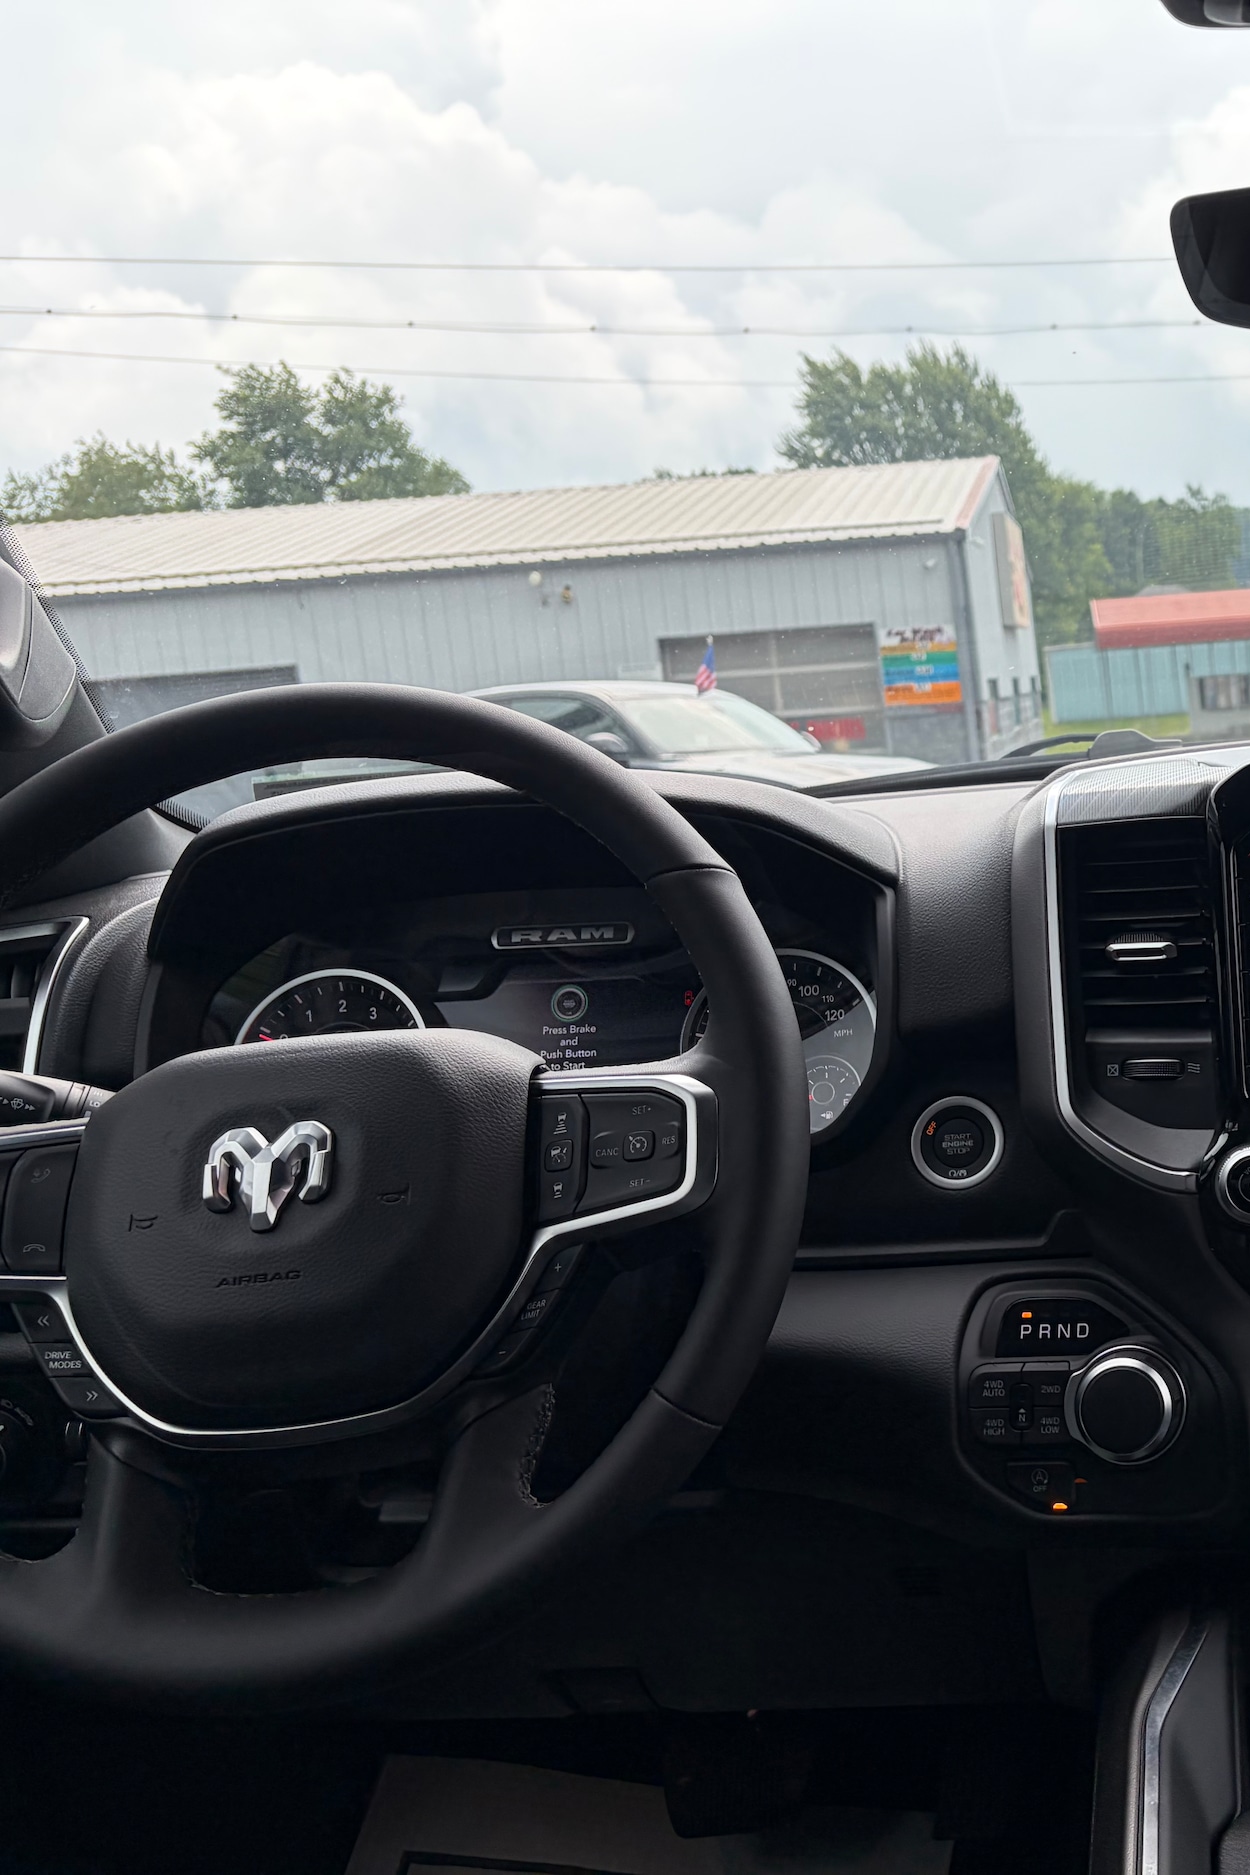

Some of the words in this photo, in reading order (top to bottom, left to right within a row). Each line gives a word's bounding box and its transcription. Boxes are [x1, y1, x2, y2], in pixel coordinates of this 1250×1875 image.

[511, 926, 615, 943] RAM
[787, 978, 797, 987] 90
[798, 984, 820, 997] 100
[821, 995, 835, 1003] 110
[338, 999, 348, 1013] 2
[305, 1009, 313, 1022] 1
[369, 1006, 378, 1020] 3
[824, 1008, 846, 1021] 120
[543, 1025, 567, 1035] Press
[569, 1023, 597, 1034] Brake
[833, 1028, 853, 1038] MPH
[559, 1037, 579, 1047] and
[540, 1049, 563, 1060] Push
[565, 1048, 597, 1058] Button
[551, 1062, 561, 1070] to
[563, 1061, 586, 1070] Start
[926, 1120, 937, 1136] OFF
[661, 1135, 676, 1145] RES
[944, 1132, 972, 1141] START
[942, 1139, 974, 1148] ENGINE
[595, 1147, 619, 1158] CANC
[947, 1147, 971, 1156] STOP
[215, 1269, 301, 1288] AIRBAG
[527, 1299, 547, 1311] GEAR
[520, 1309, 540, 1321] LIMIT
[44, 1351, 73, 1360] DRIVE
[48, 1360, 83, 1369] MODES
[984, 1379, 1005, 1389] 4WD
[982, 1388, 1006, 1397] AUTO
[1041, 1385, 1061, 1394] 2WD
[1018, 1413, 1026, 1423] N
[1040, 1416, 1060, 1425] 4WD
[984, 1419, 1005, 1428] 4WD
[983, 1427, 1005, 1436] HIGH
[1040, 1425, 1060, 1434] LOW
[1032, 1485, 1048, 1493] OFF
